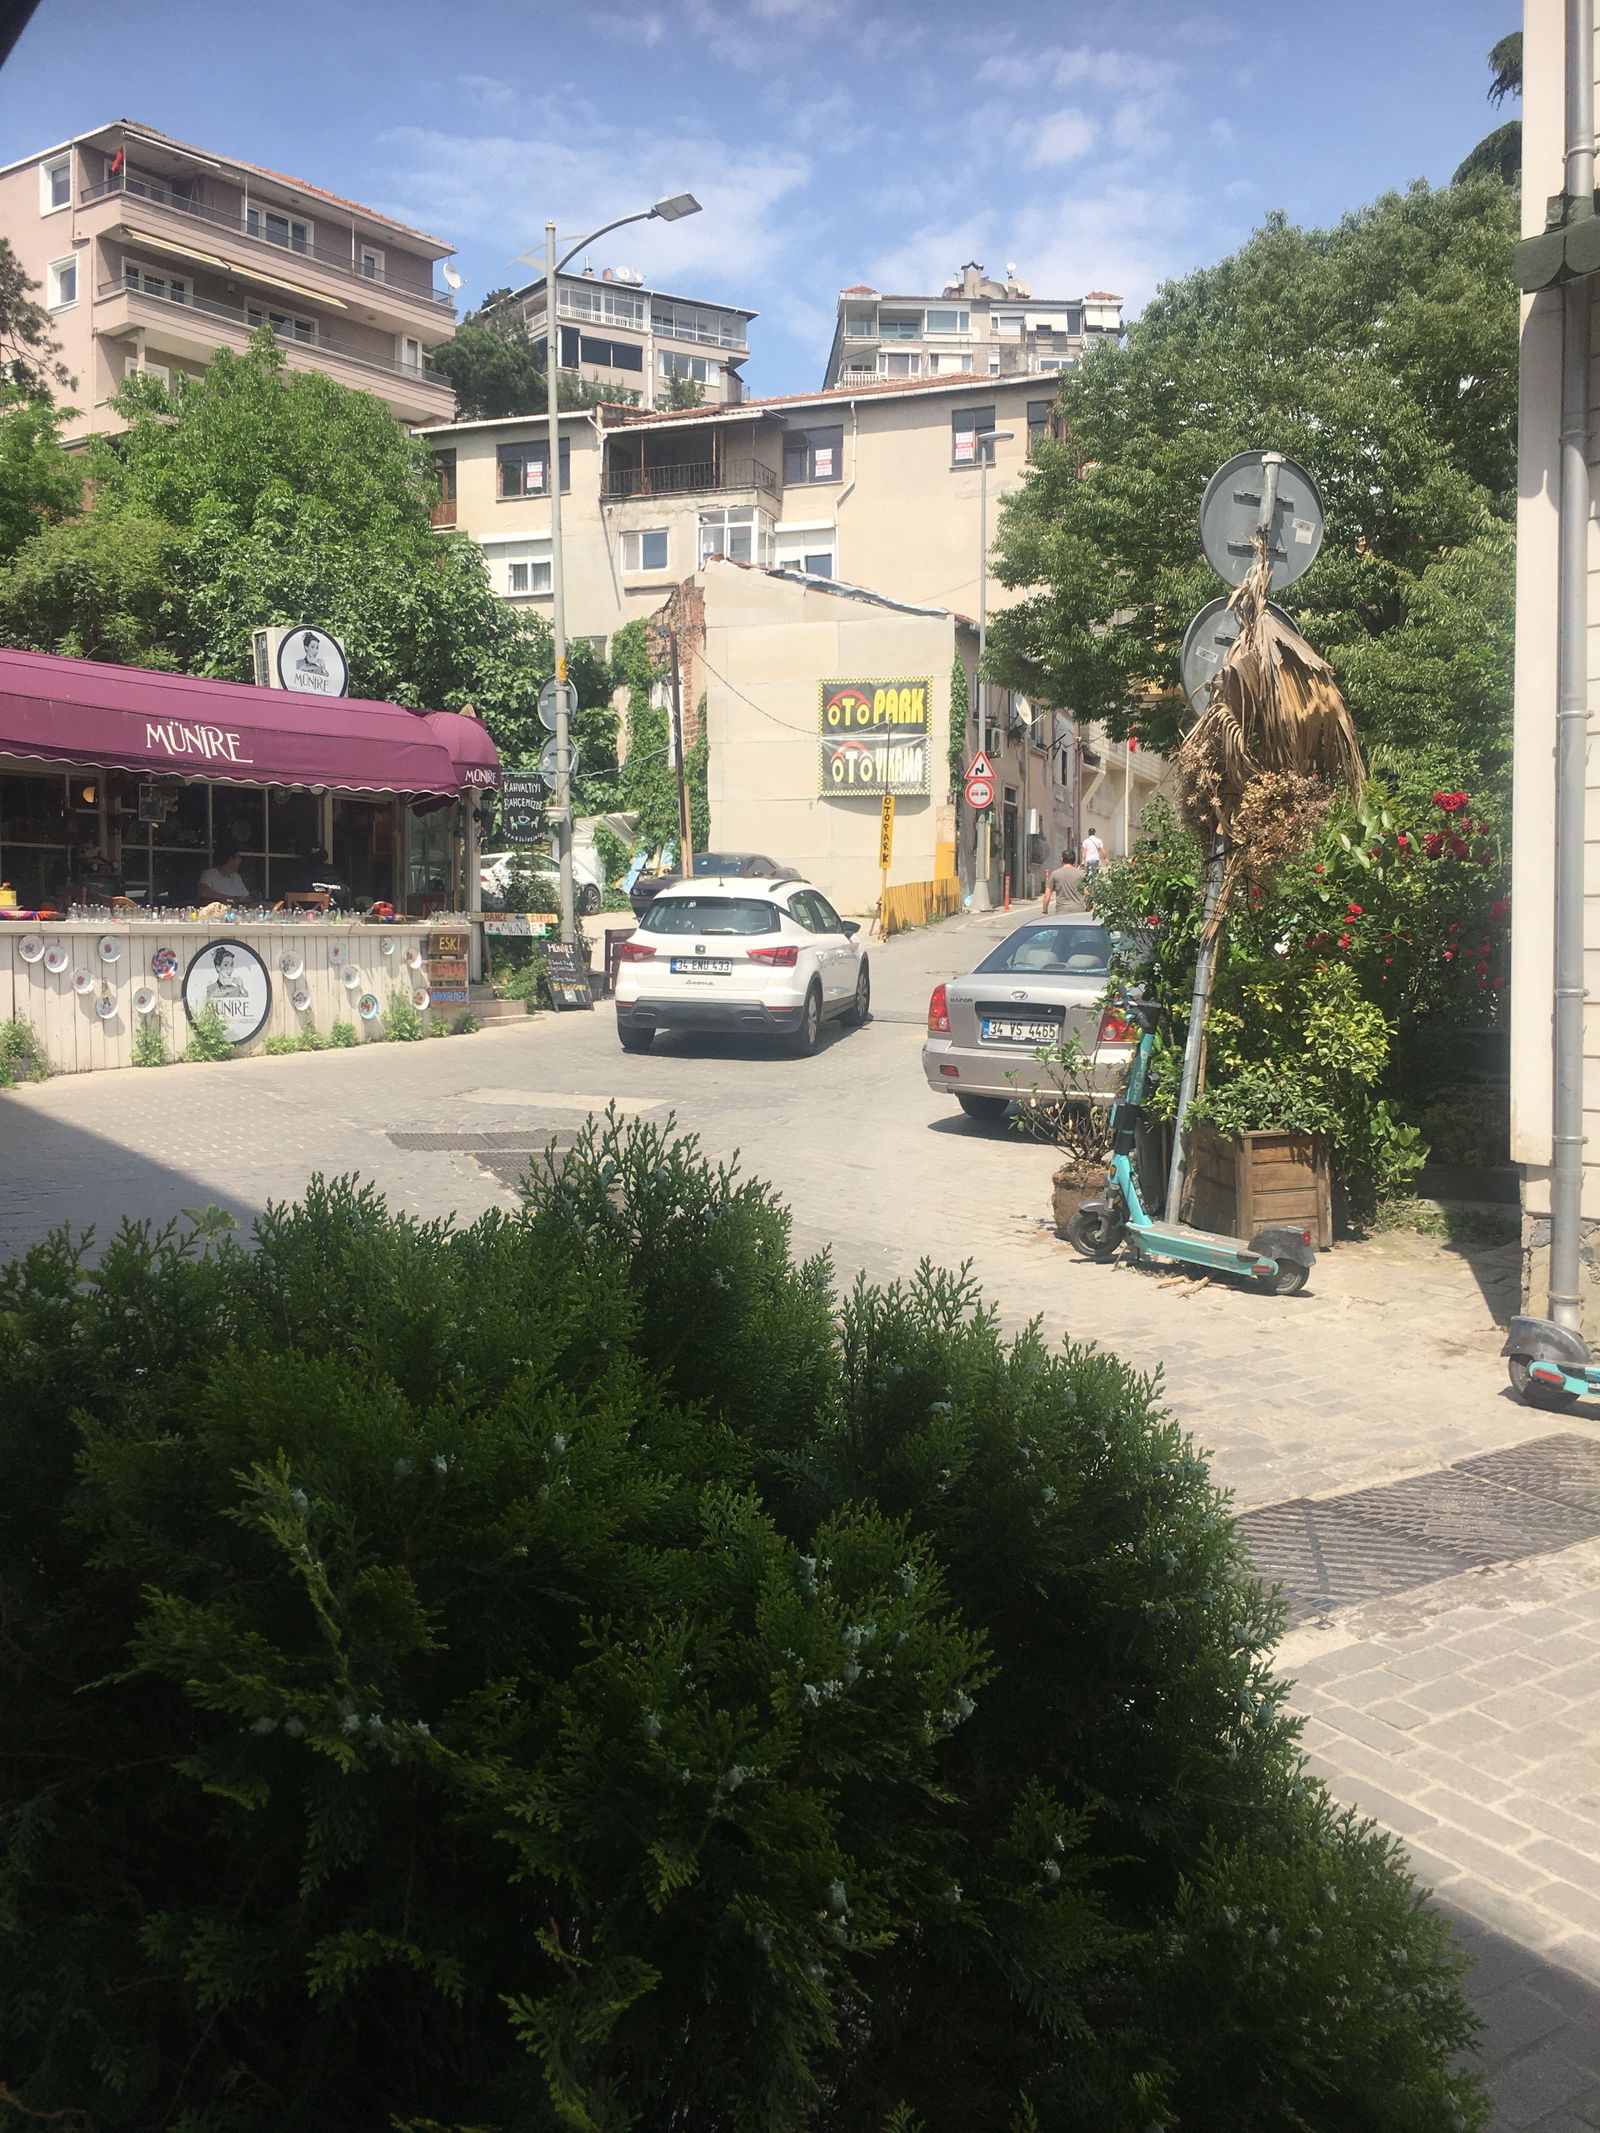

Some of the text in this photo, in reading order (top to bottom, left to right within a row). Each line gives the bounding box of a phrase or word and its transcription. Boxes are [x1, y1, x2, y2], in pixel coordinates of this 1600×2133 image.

[827, 688, 925, 726] OTO PARK
[145, 721, 254, 764] MÜNİRE
[831, 747, 923, 784] OTO YIKAMA
[677, 960, 688, 970] 34
[712, 961, 730, 972] 433
[990, 1021, 1056, 1039] 34 VS 4465
